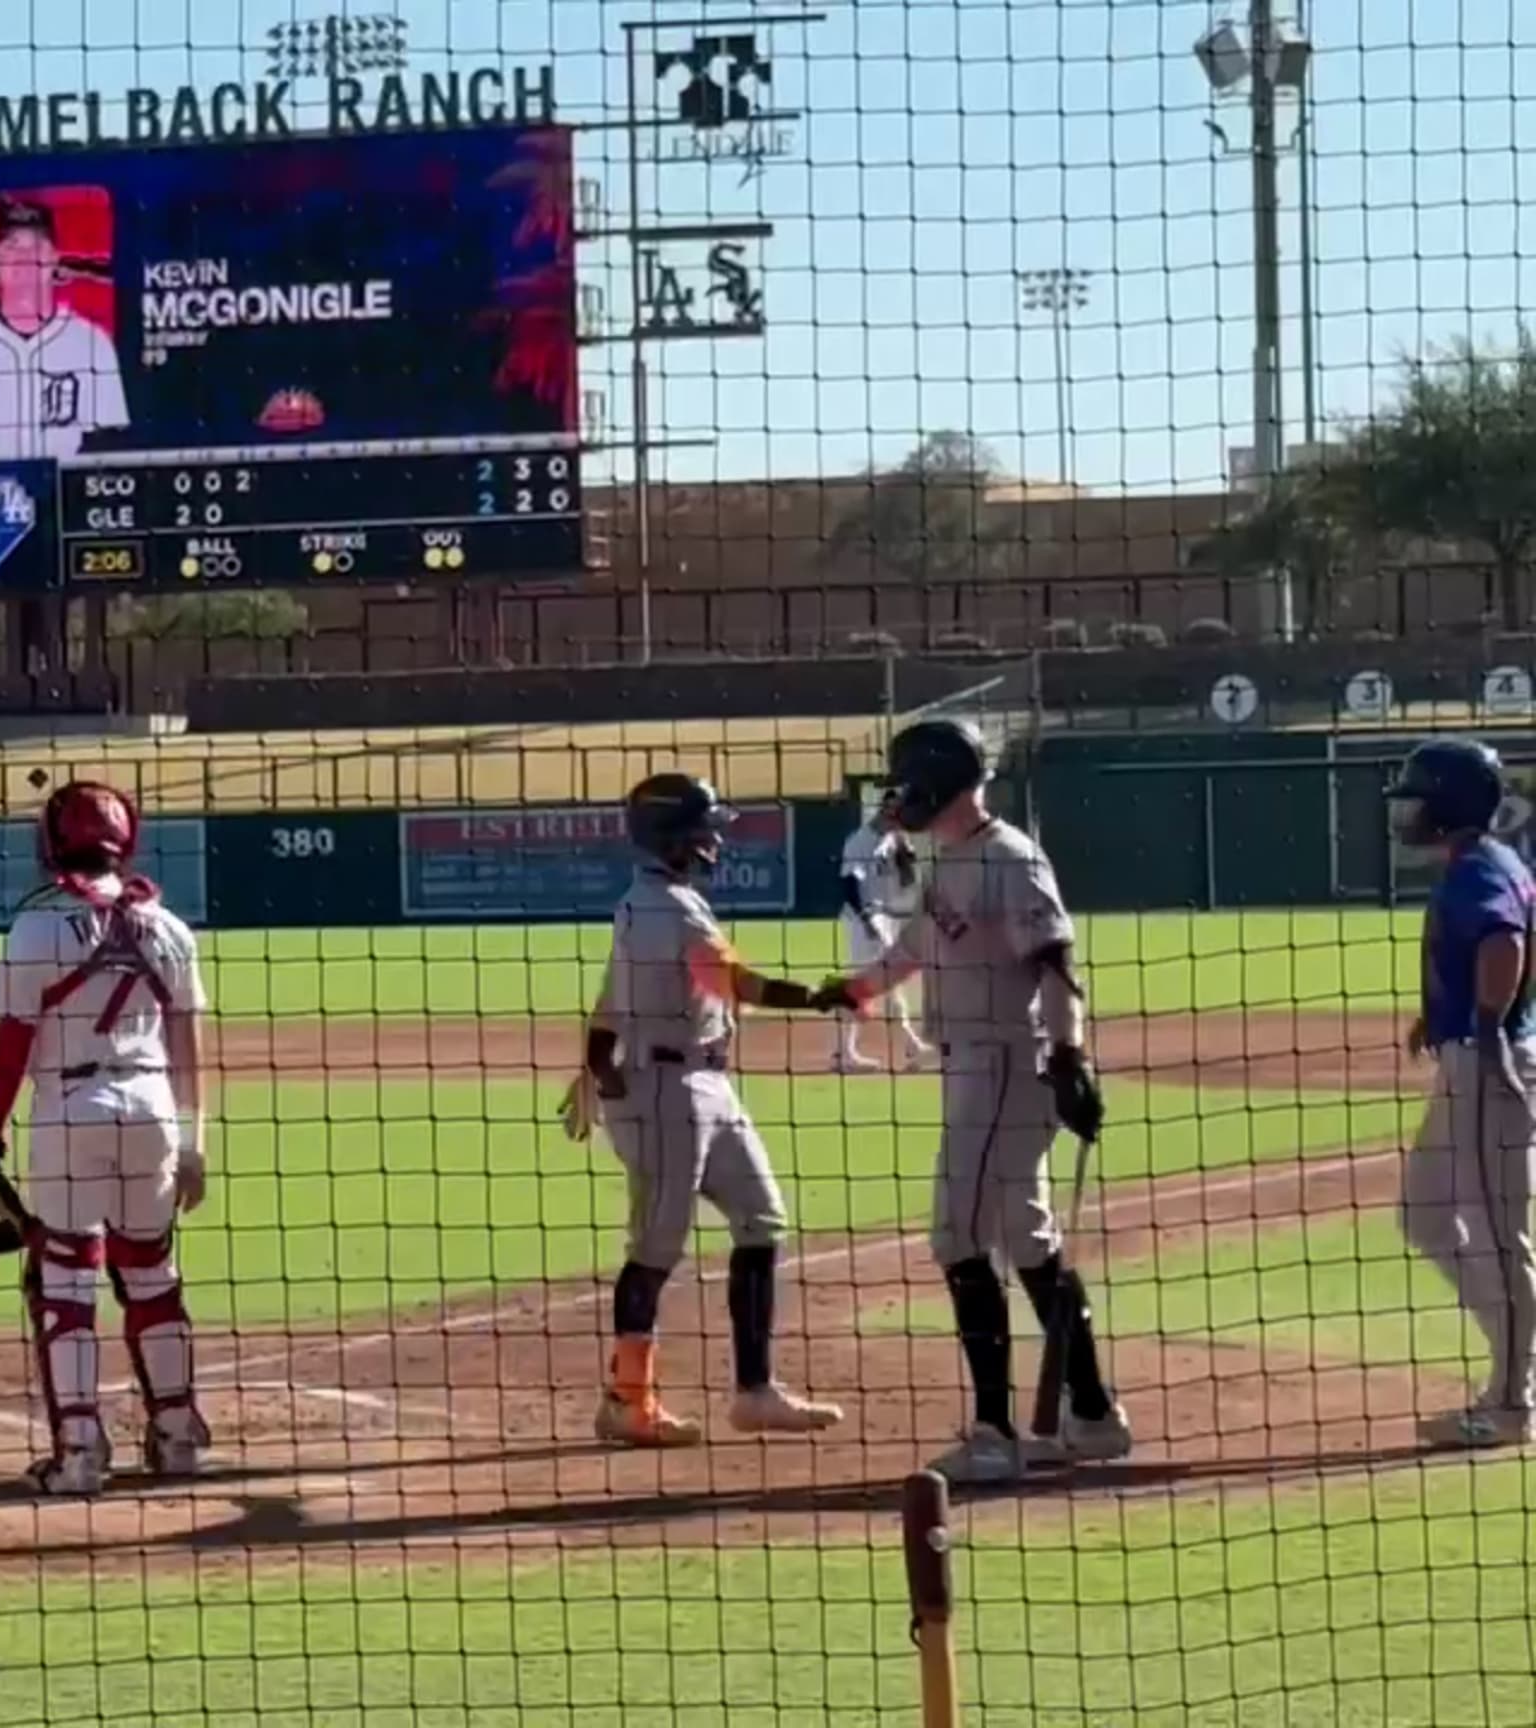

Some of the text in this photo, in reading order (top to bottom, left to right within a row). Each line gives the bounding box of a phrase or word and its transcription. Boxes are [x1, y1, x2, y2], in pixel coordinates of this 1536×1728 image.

[329, 65, 554, 135] RANCH
[144, 258, 228, 288] KEVIN
[142, 280, 392, 328] MCGONIGLE
[85, 456, 568, 496] SCO 0 0 2 2 3 0
[87, 489, 569, 528] GLE 2 0 2 2 0
[187, 537, 235, 555] BALL
[299, 533, 367, 551] STRIKE
[82, 551, 132, 572] 2:06
[272, 829, 334, 857] 380
